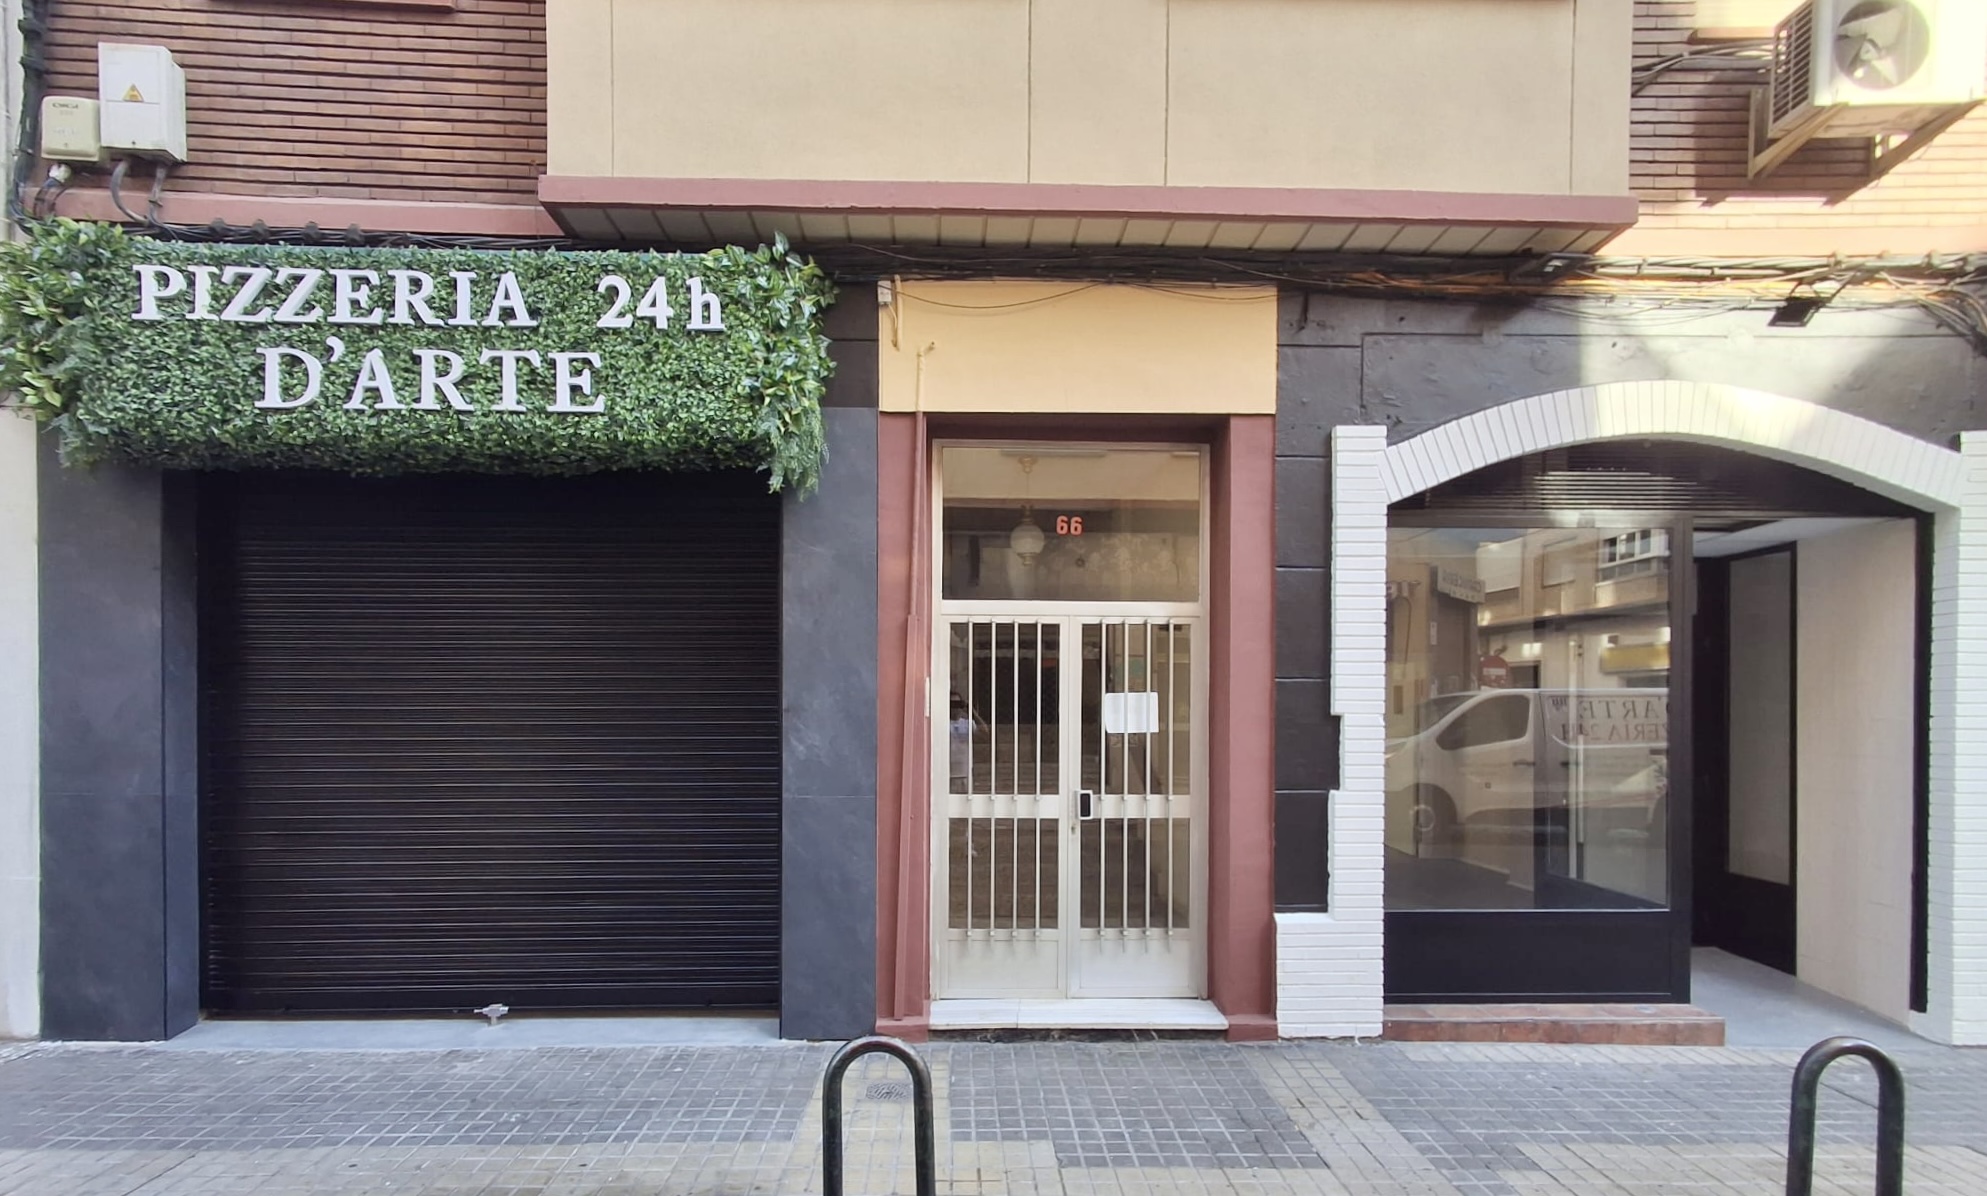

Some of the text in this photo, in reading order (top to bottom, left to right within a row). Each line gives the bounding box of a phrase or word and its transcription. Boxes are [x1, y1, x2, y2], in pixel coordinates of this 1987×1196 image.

[131, 264, 726, 332] PIZZERIA 24h
[254, 336, 605, 413] D'ARTE
[1056, 515, 1083, 536] 66
